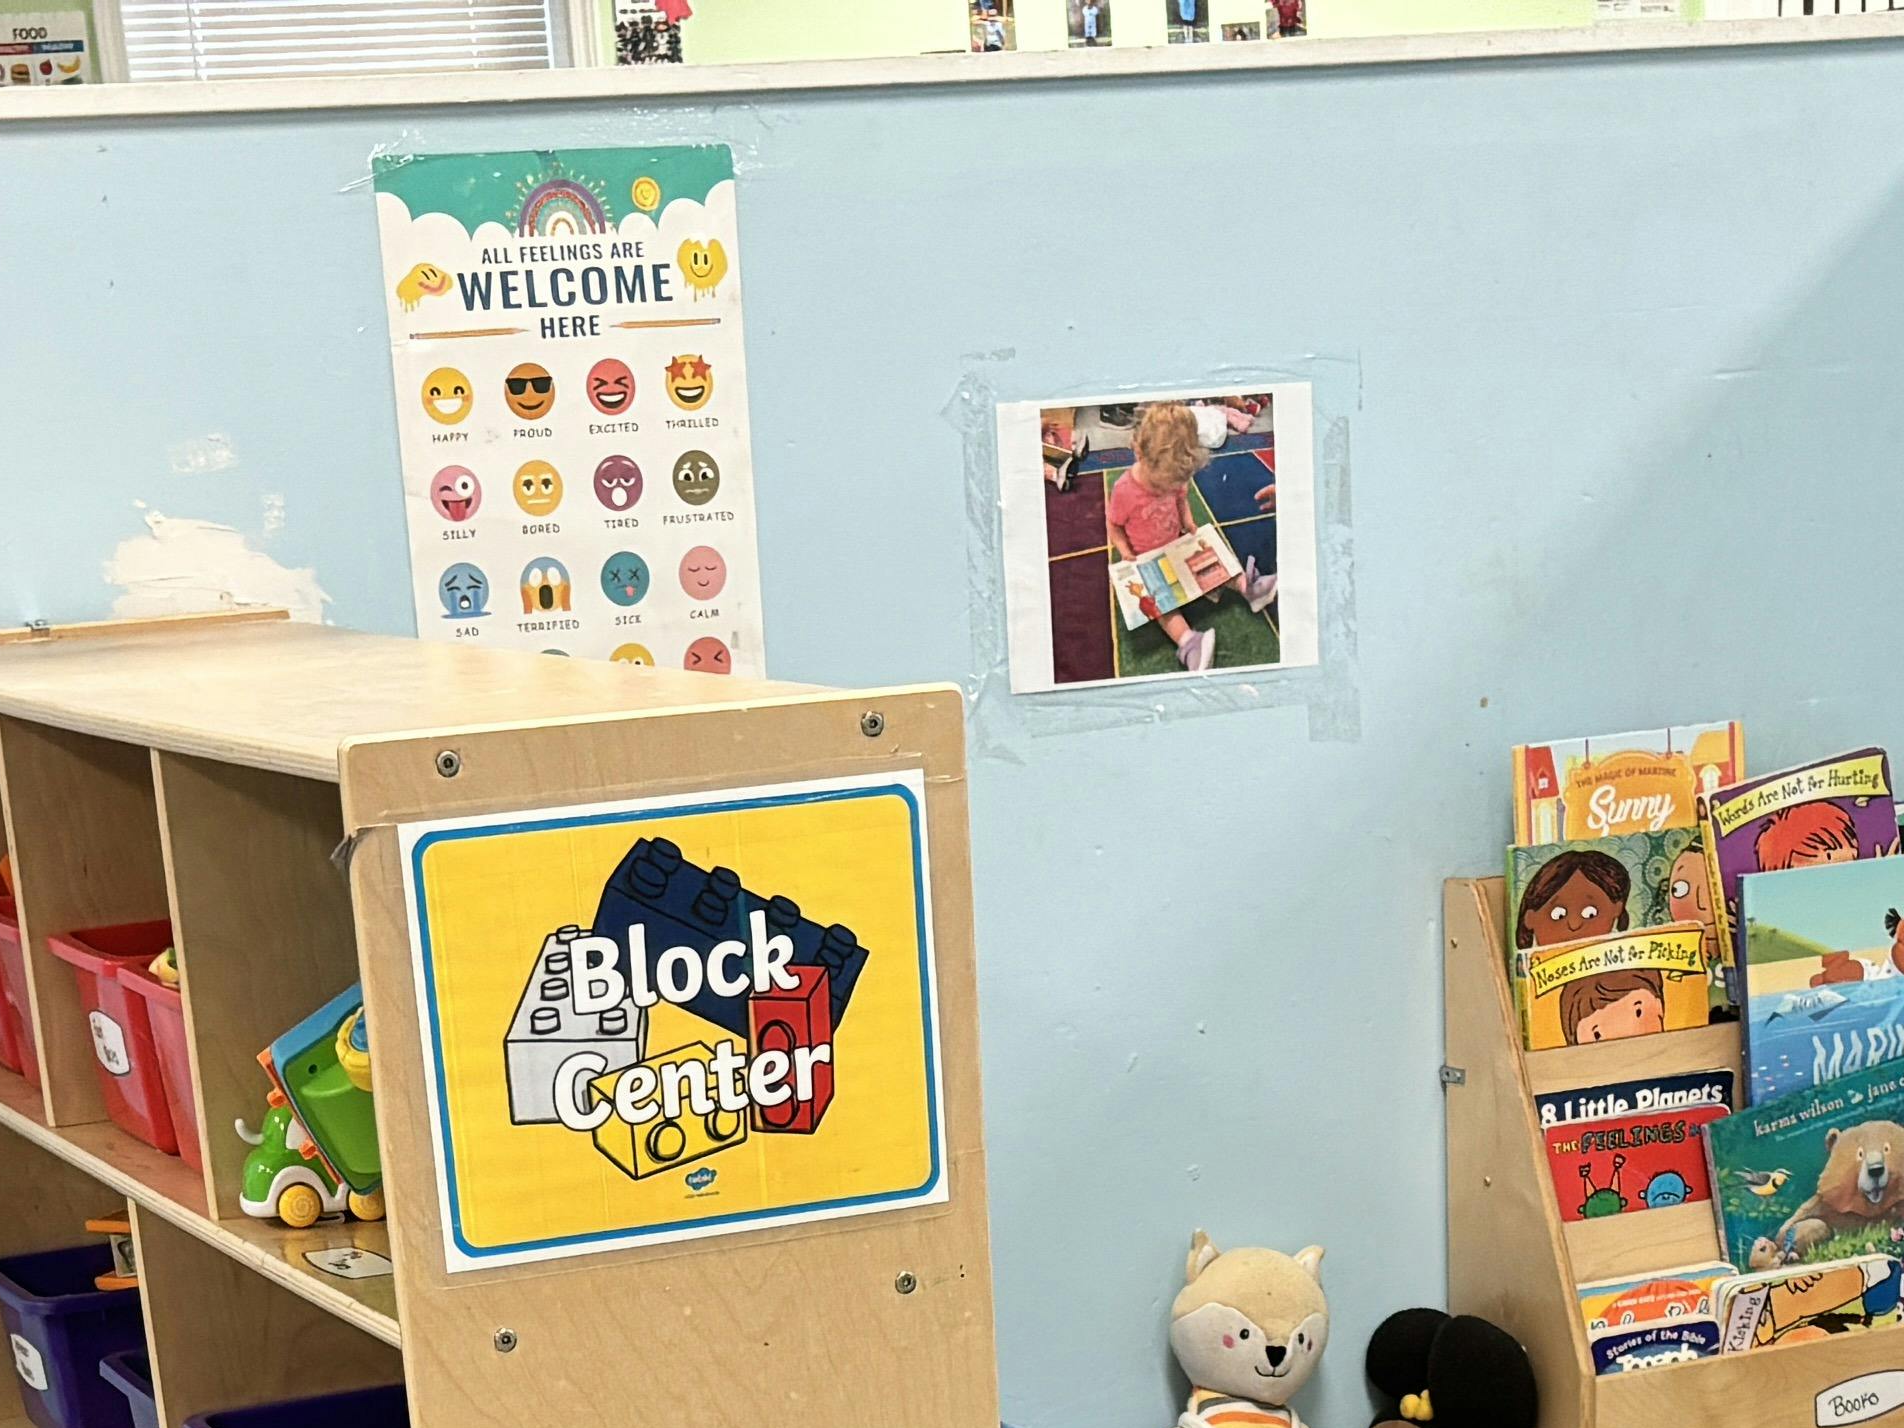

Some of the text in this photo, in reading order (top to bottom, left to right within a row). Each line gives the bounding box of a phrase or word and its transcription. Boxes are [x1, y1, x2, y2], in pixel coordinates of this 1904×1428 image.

[12, 27, 47, 40] FOOD
[481, 240, 645, 265] ALL FEELINGS ARE
[456, 262, 675, 312] WELCOME
[539, 314, 602, 340] HERE
[589, 422, 639, 435] EXCITED
[665, 417, 720, 430] THRILLED
[432, 431, 469, 443] HAPPY
[512, 427, 553, 439] PROUD
[604, 517, 640, 530] TIRED
[662, 510, 735, 526] FRUSTRATED
[442, 528, 477, 541] SILLY
[521, 522, 561, 536] BORED
[615, 614, 642, 627] SICK
[689, 608, 721, 620] CALM
[455, 626, 480, 638] SAD
[516, 619, 580, 633] TERRIFIED
[1717, 768, 1880, 826] Words Are Not for Hurting
[1587, 785, 1676, 831] Sunny
[568, 910, 800, 1016] Block
[1536, 941, 1697, 990] Noses Are Not for Picking
[553, 1040, 832, 1131] Center
[1540, 1082, 1723, 1125] 8 Little Planets
[1753, 1114, 1798, 1138] karma
[1798, 1093, 1844, 1122] wilson
[1867, 1077, 1898, 1104] jane
[1552, 1140, 1579, 1155] THE
[1580, 1119, 1686, 1154] FEELINGS
[1606, 1328, 1706, 1360] Stories of the Bible
